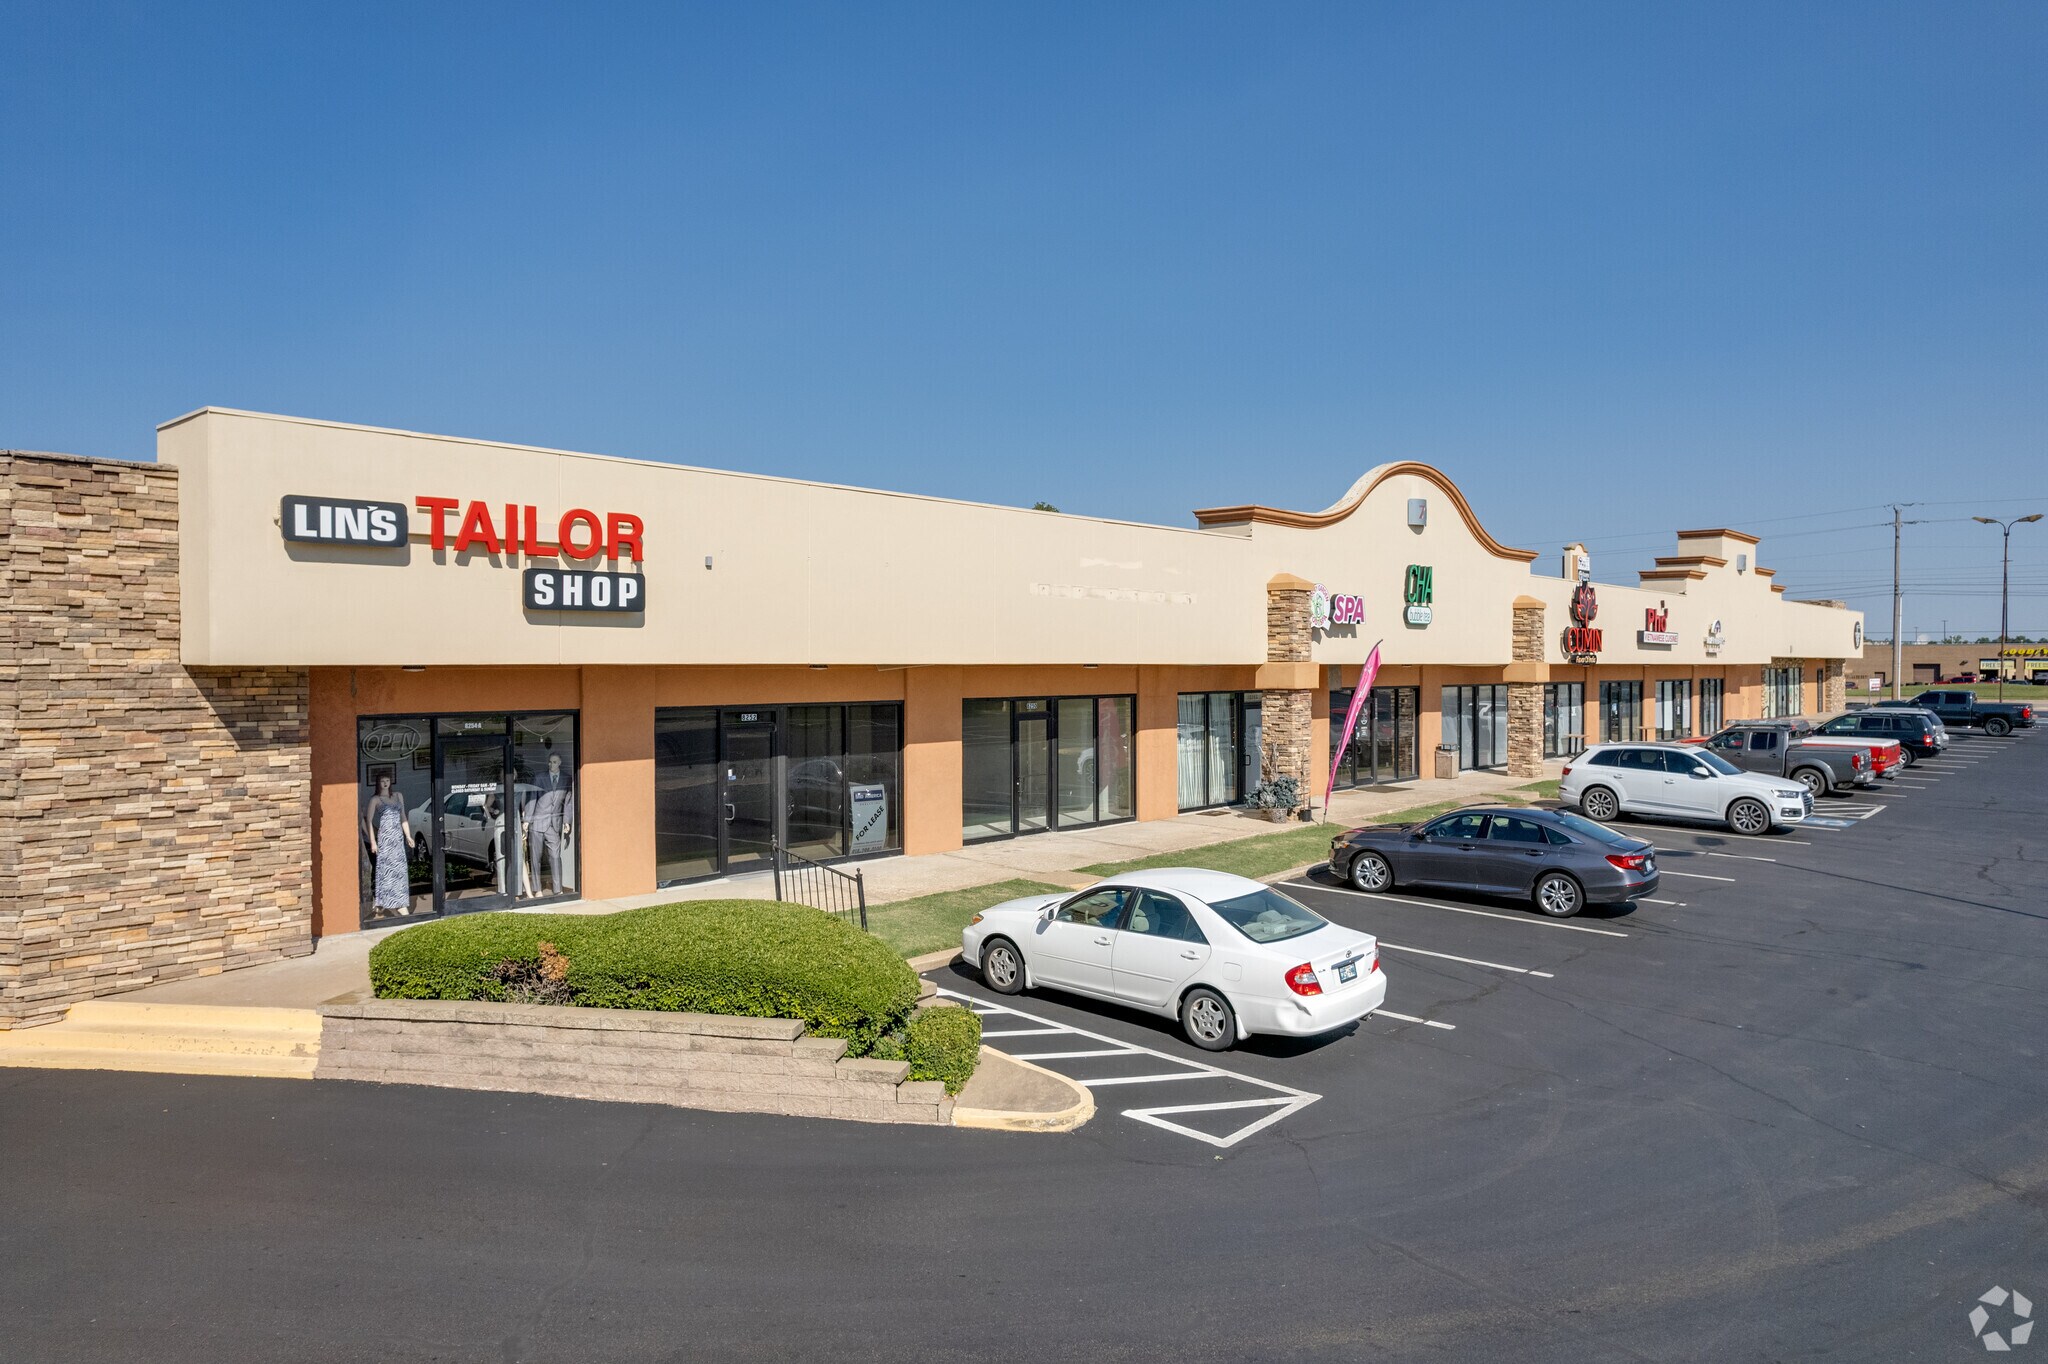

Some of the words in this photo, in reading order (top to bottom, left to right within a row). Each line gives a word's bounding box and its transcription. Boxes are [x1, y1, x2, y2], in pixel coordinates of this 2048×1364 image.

[293, 503, 397, 542] LIN'S
[415, 495, 644, 562] TAILOR
[533, 572, 638, 609] SHOP
[1408, 564, 1433, 604] CHA
[1333, 595, 1365, 623] SPA
[1567, 627, 1603, 652] CUMIN
[365, 731, 416, 752] OPEN
[855, 825, 869, 841] FOR
[867, 805, 885, 827] LEASE
